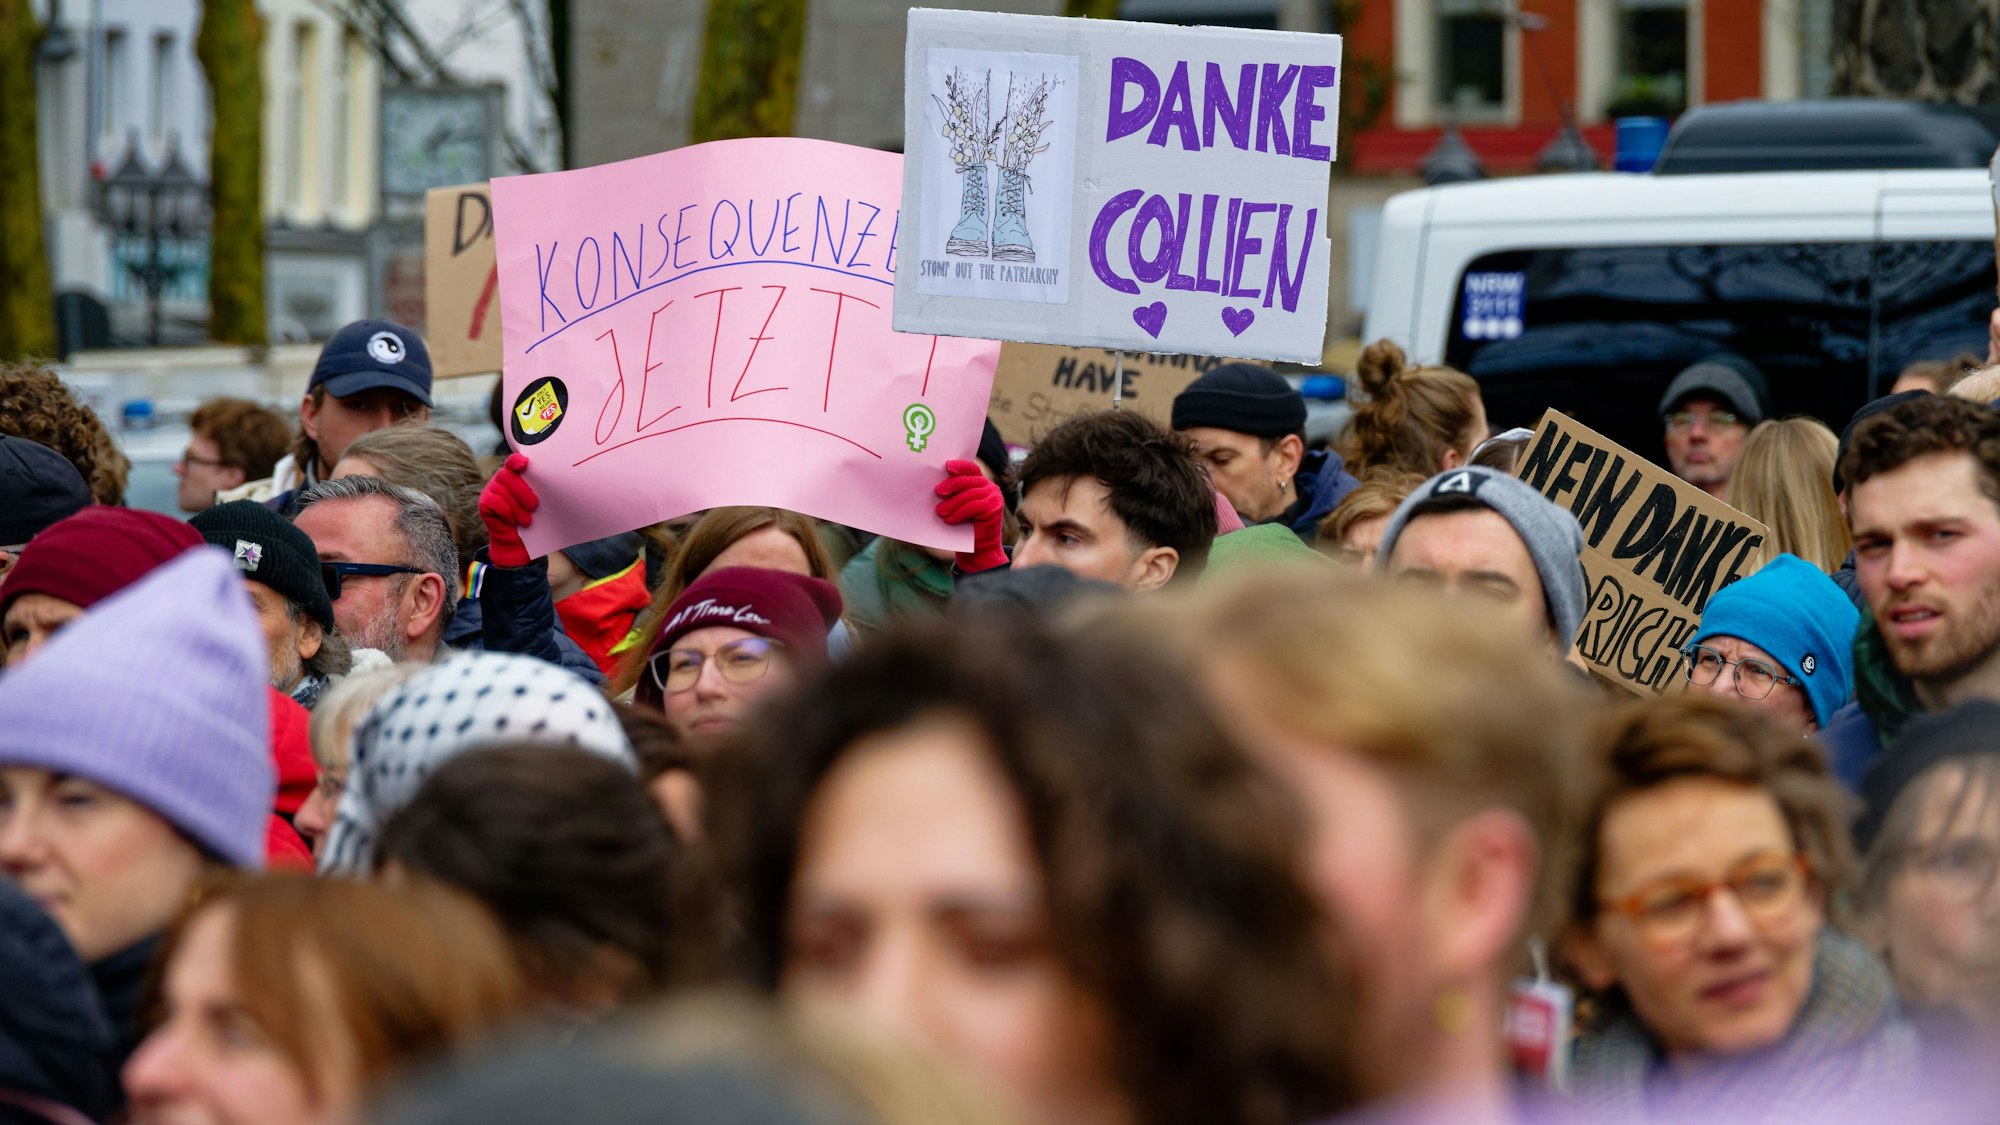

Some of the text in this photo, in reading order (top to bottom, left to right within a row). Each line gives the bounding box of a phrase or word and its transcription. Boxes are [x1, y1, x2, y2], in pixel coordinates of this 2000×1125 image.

[1106, 57, 1336, 162] DANKE
[1089, 189, 1318, 313] COLLIEN
[920, 259, 1059, 285] STOMP OUT THE PATRIARCHY
[1466, 273, 1523, 294] NRW
[1053, 357, 1142, 398] HAVE
[537, 391, 551, 405] YES
[542, 404, 556, 419] YES
[1519, 420, 1764, 615] NEIN DANKE
[691, 598, 736, 623] Time
[1576, 560, 1700, 694] RICH
